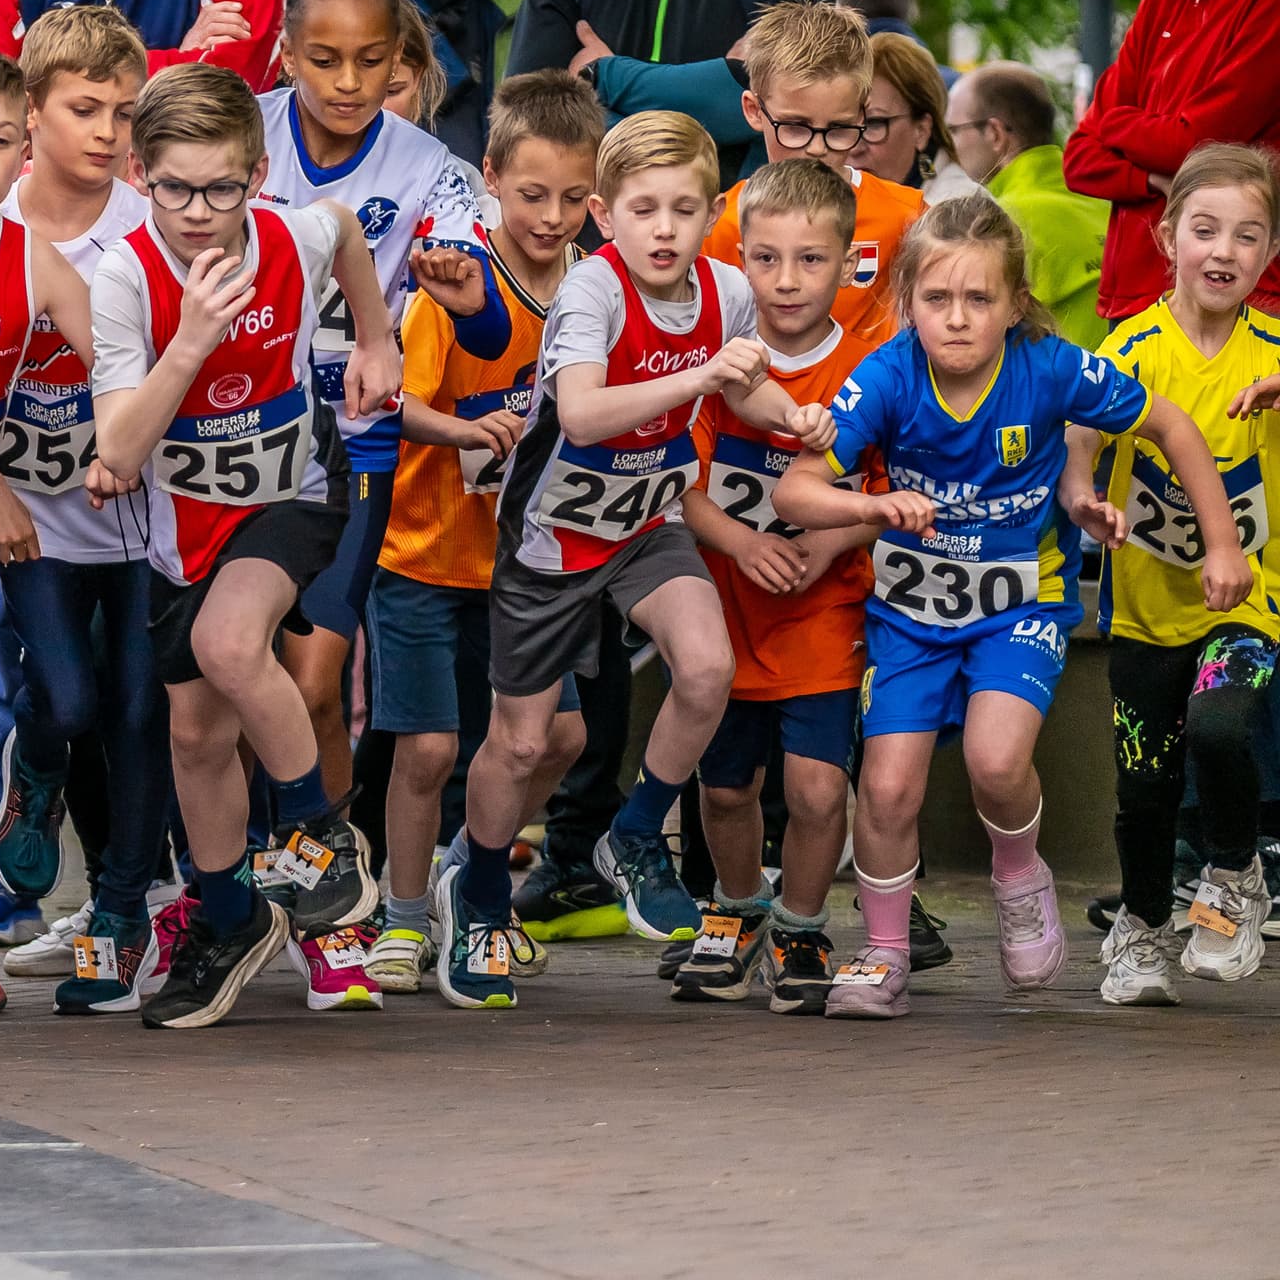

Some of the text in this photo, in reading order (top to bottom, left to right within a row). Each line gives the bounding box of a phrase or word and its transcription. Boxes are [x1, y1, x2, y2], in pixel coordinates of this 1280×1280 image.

[17, 378, 89, 397] RUNNERS
[24, 400, 66, 417] LOPERS
[24, 408, 66, 425] COMPANY
[48, 418, 79, 431] TILBURG
[196, 413, 246, 429] LOPERS
[197, 424, 246, 438] COMPANY
[228, 426, 261, 440] TILBURG
[613, 450, 656, 463] LOPERS
[1006, 447, 1024, 457] RKC
[162, 422, 301, 499] 257
[612, 460, 655, 470] COMPANY
[549, 470, 687, 532] 240
[921, 537, 969, 554] COMPANY
[947, 552, 980, 562] TILBURG
[885, 551, 1024, 620] 230
[301, 841, 321, 856] 257
[496, 936, 506, 961] 240
